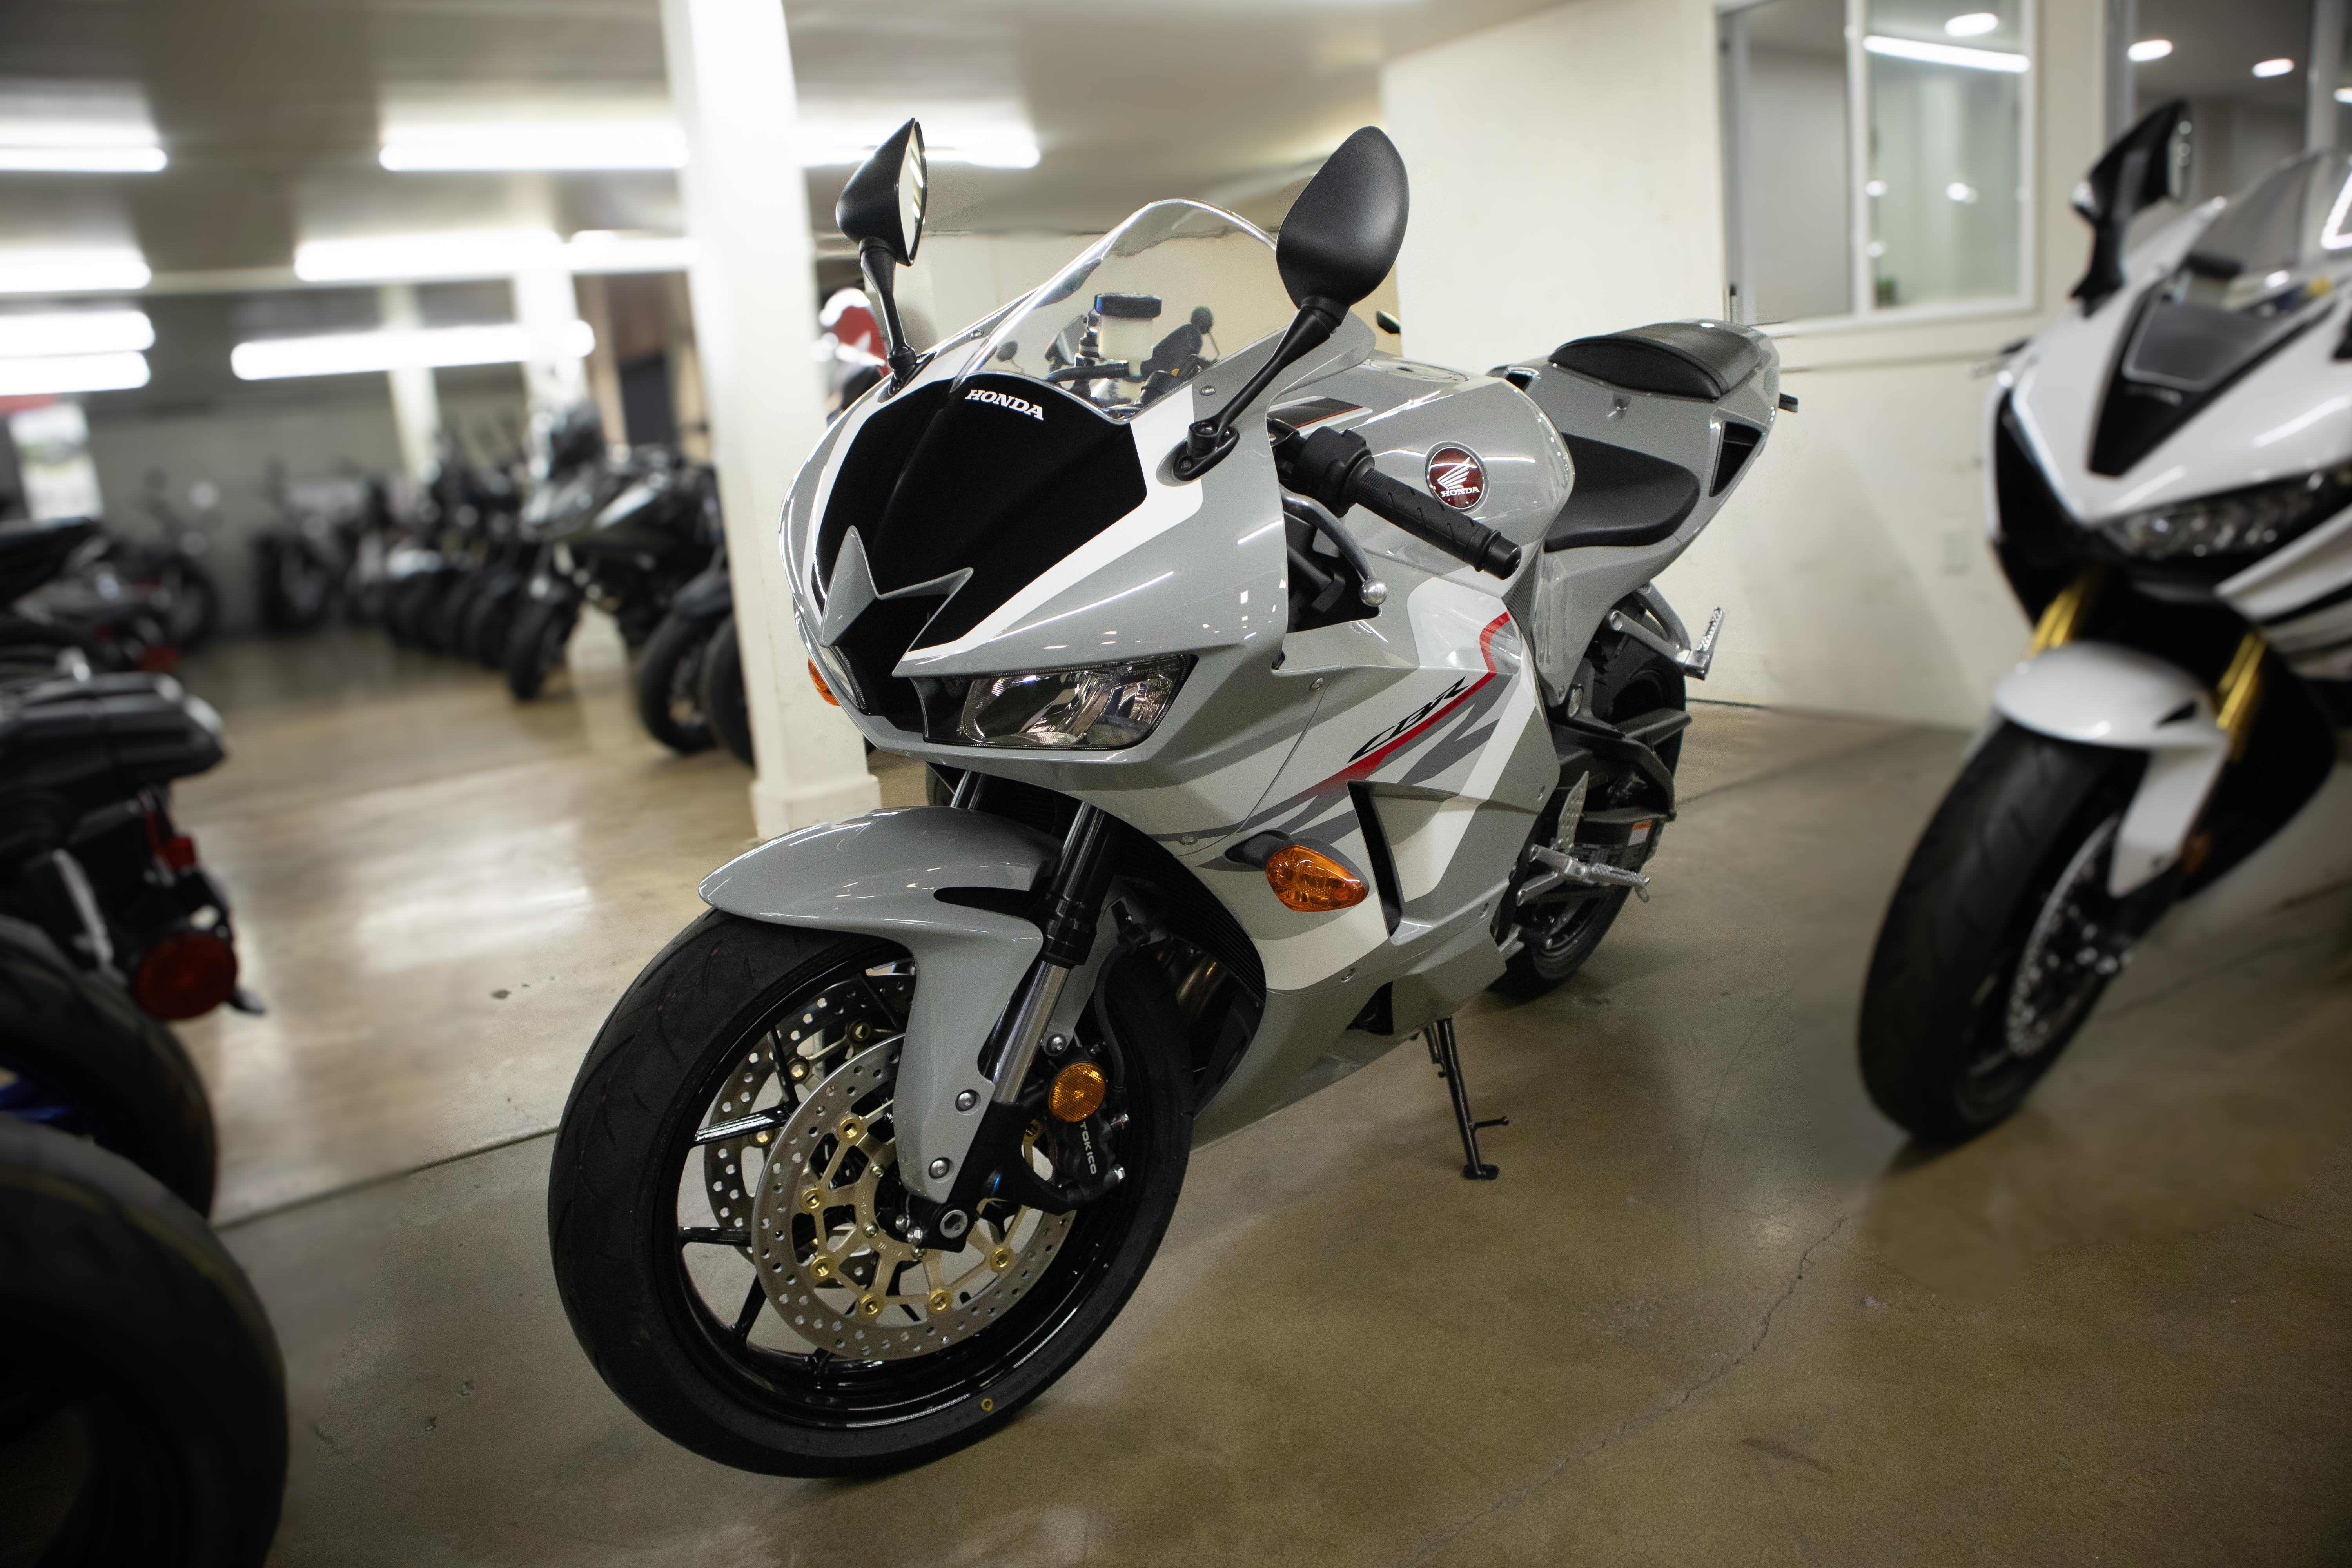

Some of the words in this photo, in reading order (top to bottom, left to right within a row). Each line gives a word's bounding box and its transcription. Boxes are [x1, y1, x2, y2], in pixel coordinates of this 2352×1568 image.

[965, 389, 1044, 421] HONDA
[1440, 486, 1480, 497] HONDA
[1347, 676, 1470, 763] CBR
[1080, 1121, 1097, 1174] TOKICO
